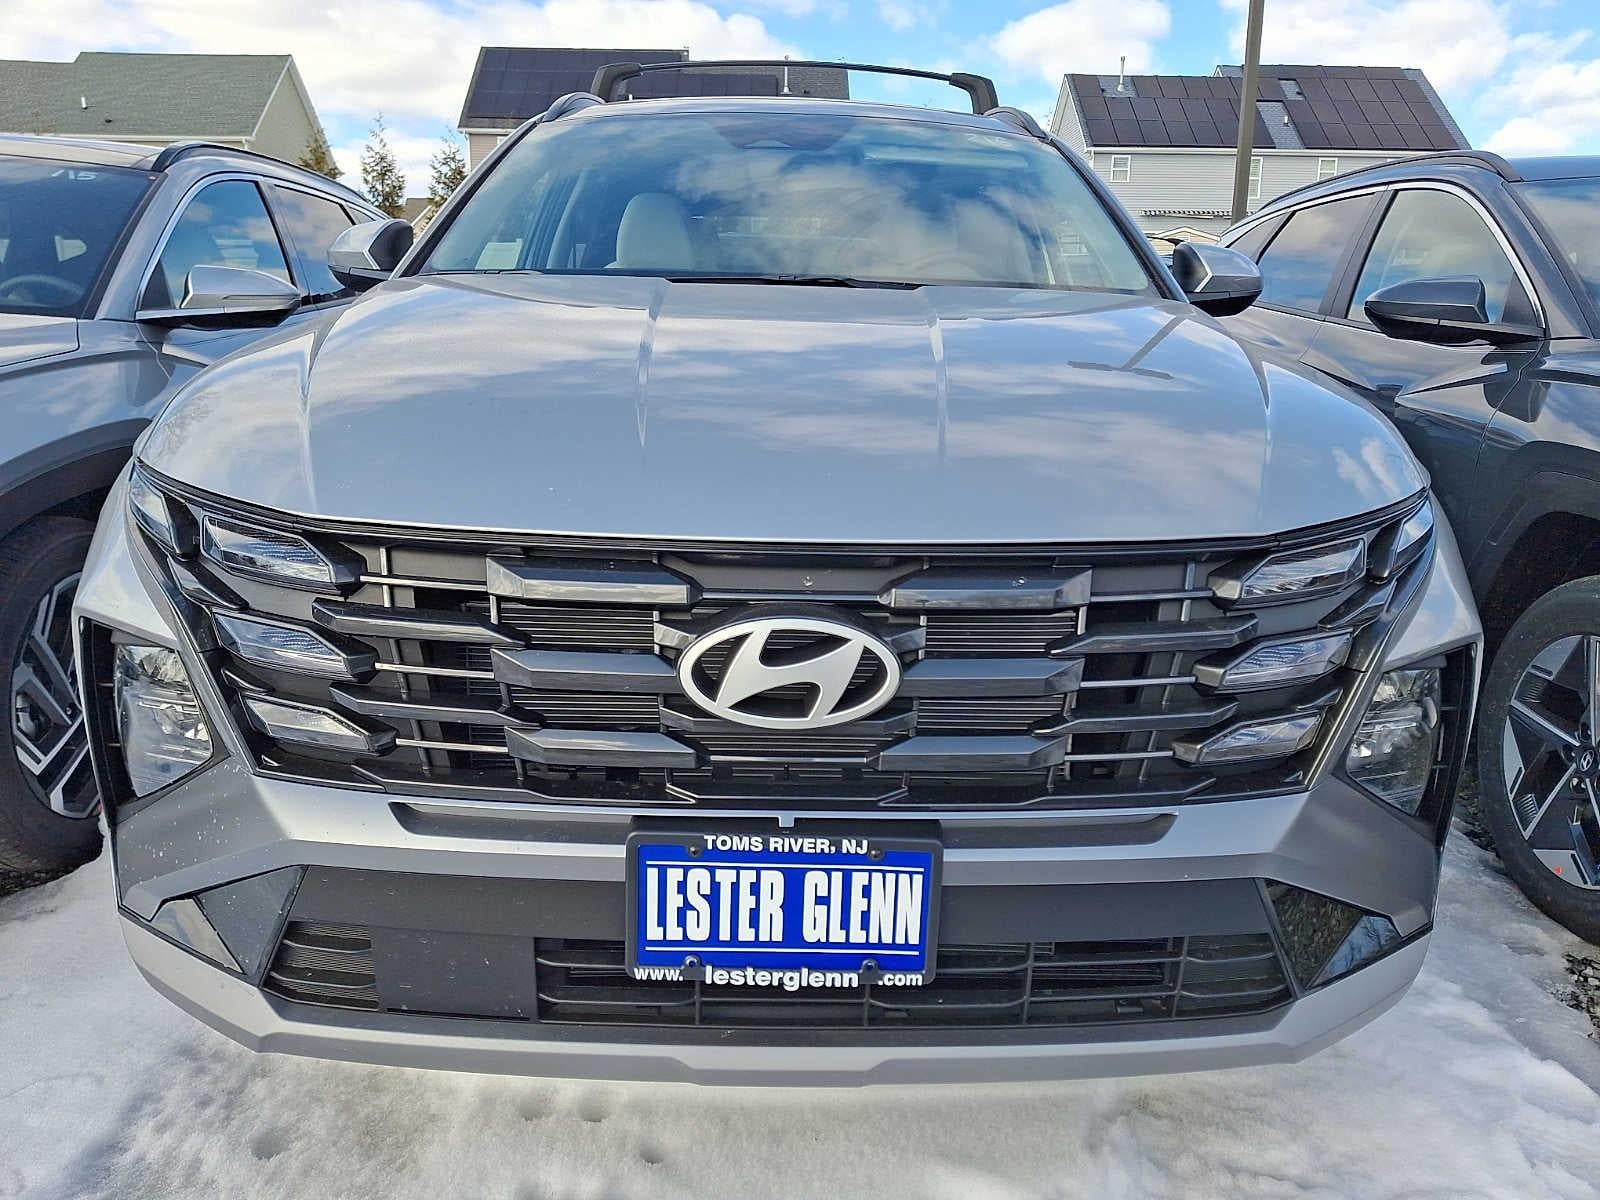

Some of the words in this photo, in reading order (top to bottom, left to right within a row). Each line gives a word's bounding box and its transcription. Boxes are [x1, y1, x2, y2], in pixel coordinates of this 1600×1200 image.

[703, 834, 764, 852] TOMS
[769, 836, 836, 854] RIVER,
[841, 839, 869, 854] NJ
[646, 867, 785, 942] LESTER
[802, 870, 923, 945] GLENN
[633, 967, 684, 981] www.
[705, 965, 859, 991] lesterglenn
[877, 972, 923, 986] .com
